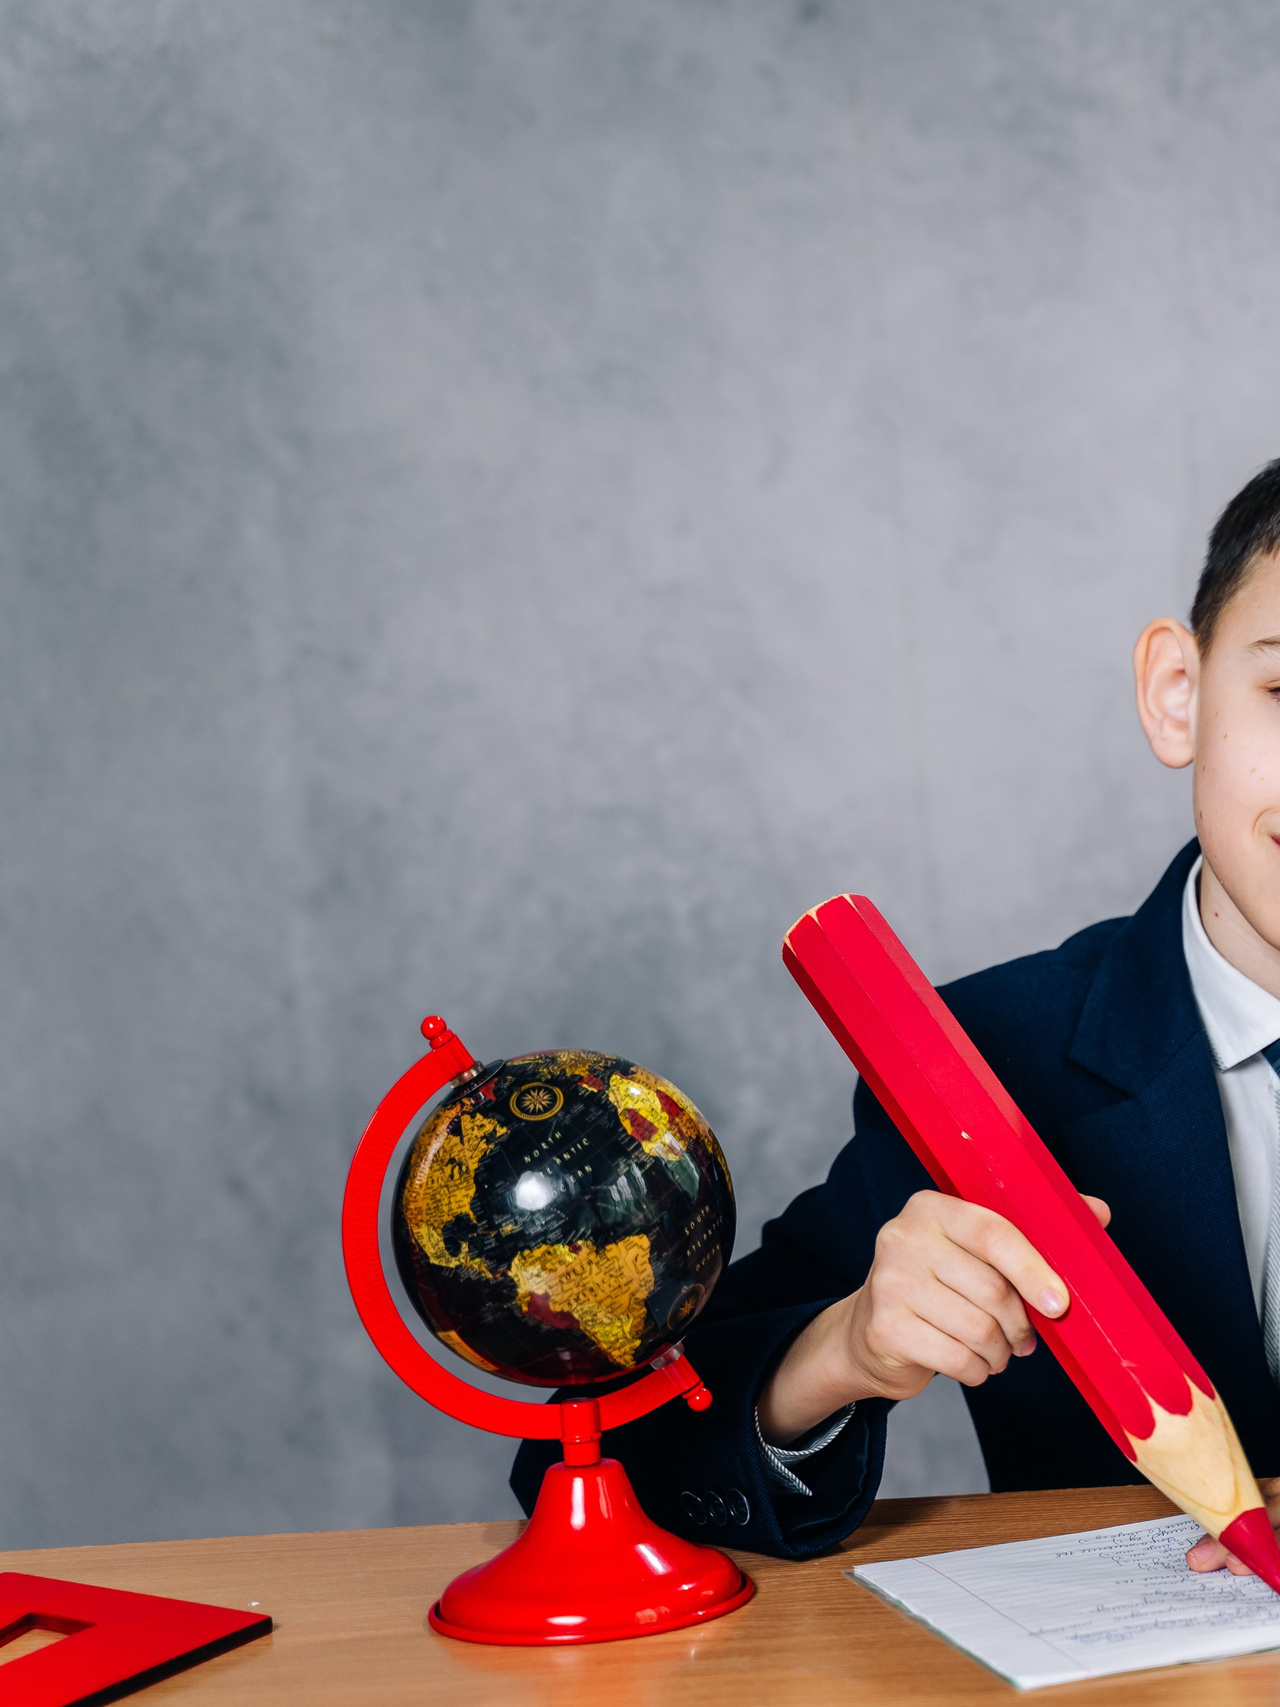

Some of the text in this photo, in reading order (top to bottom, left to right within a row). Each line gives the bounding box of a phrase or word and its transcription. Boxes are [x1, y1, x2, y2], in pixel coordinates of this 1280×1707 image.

[523, 1131, 562, 1163] NORTH
[539, 1137, 590, 1179] TLANTIC
[552, 1164, 593, 1198] OCEAN
